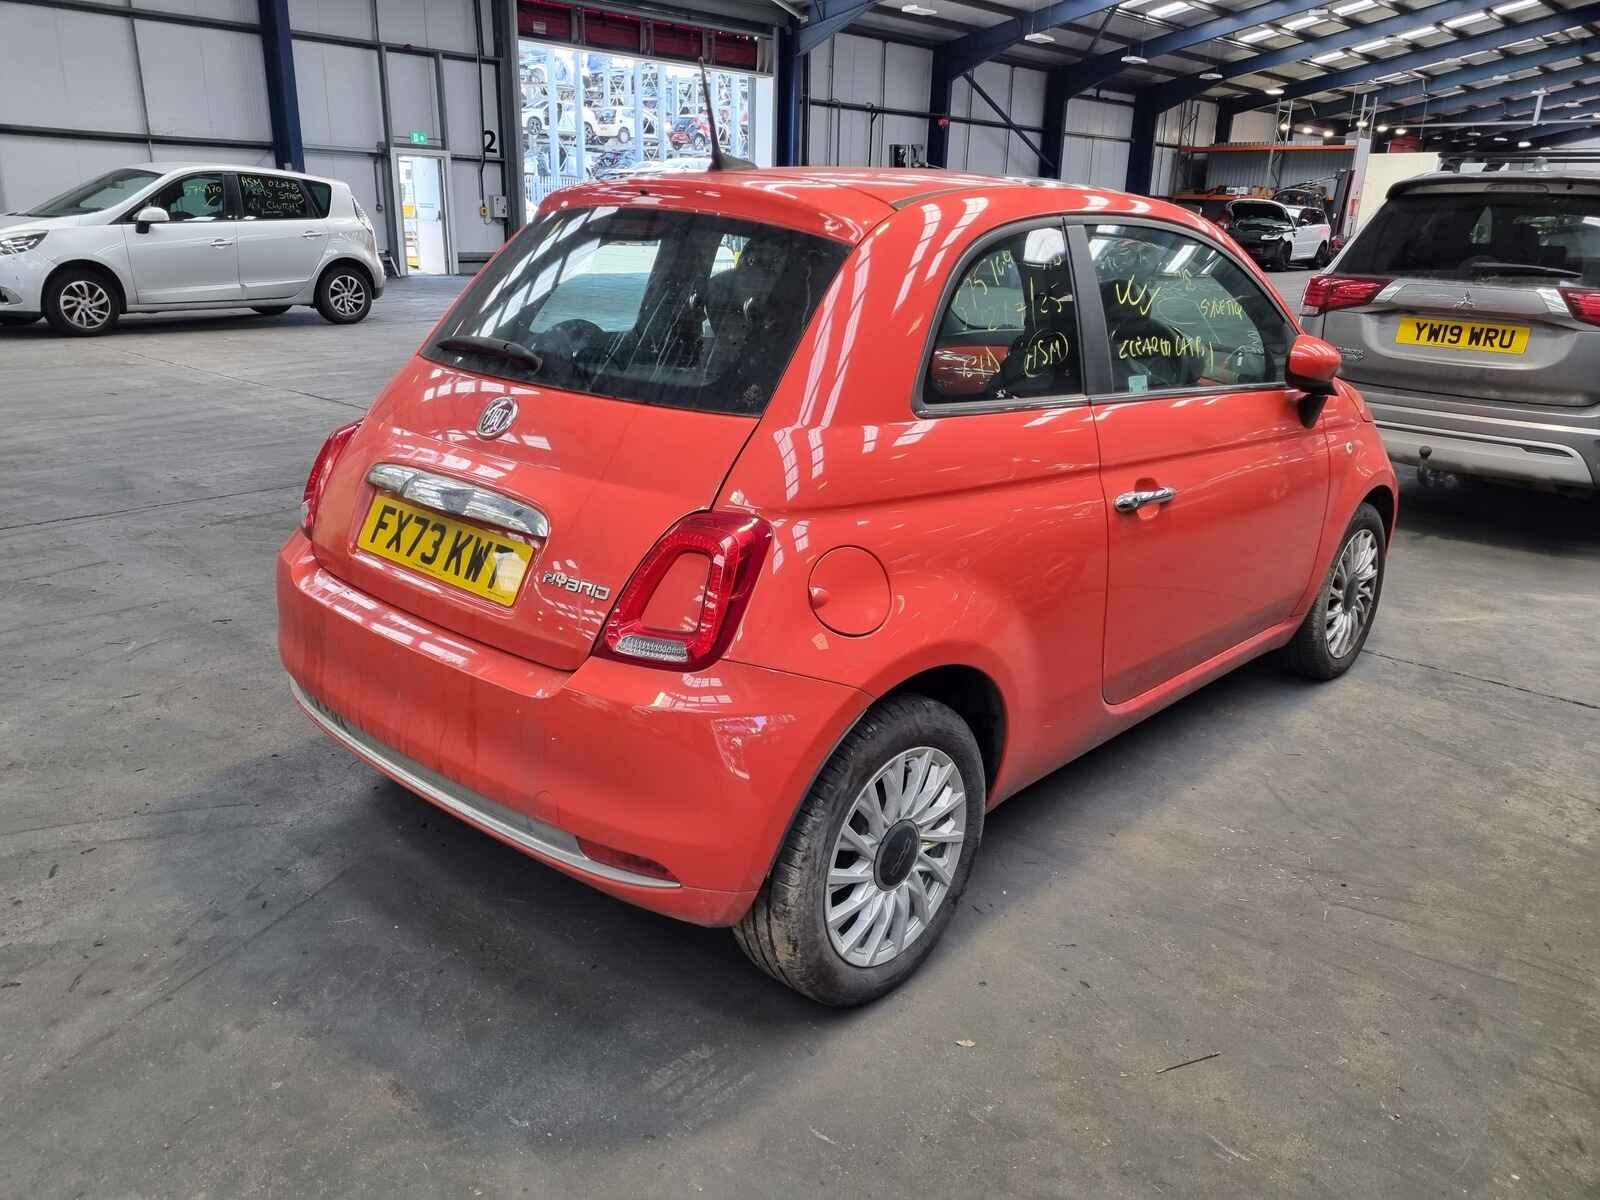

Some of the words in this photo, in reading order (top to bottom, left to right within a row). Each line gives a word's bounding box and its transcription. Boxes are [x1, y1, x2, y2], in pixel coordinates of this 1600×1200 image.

[483, 130, 497, 153] 2
[1414, 322, 1463, 344] YW19
[1467, 327, 1516, 349] WRU
[370, 508, 445, 564] FX73
